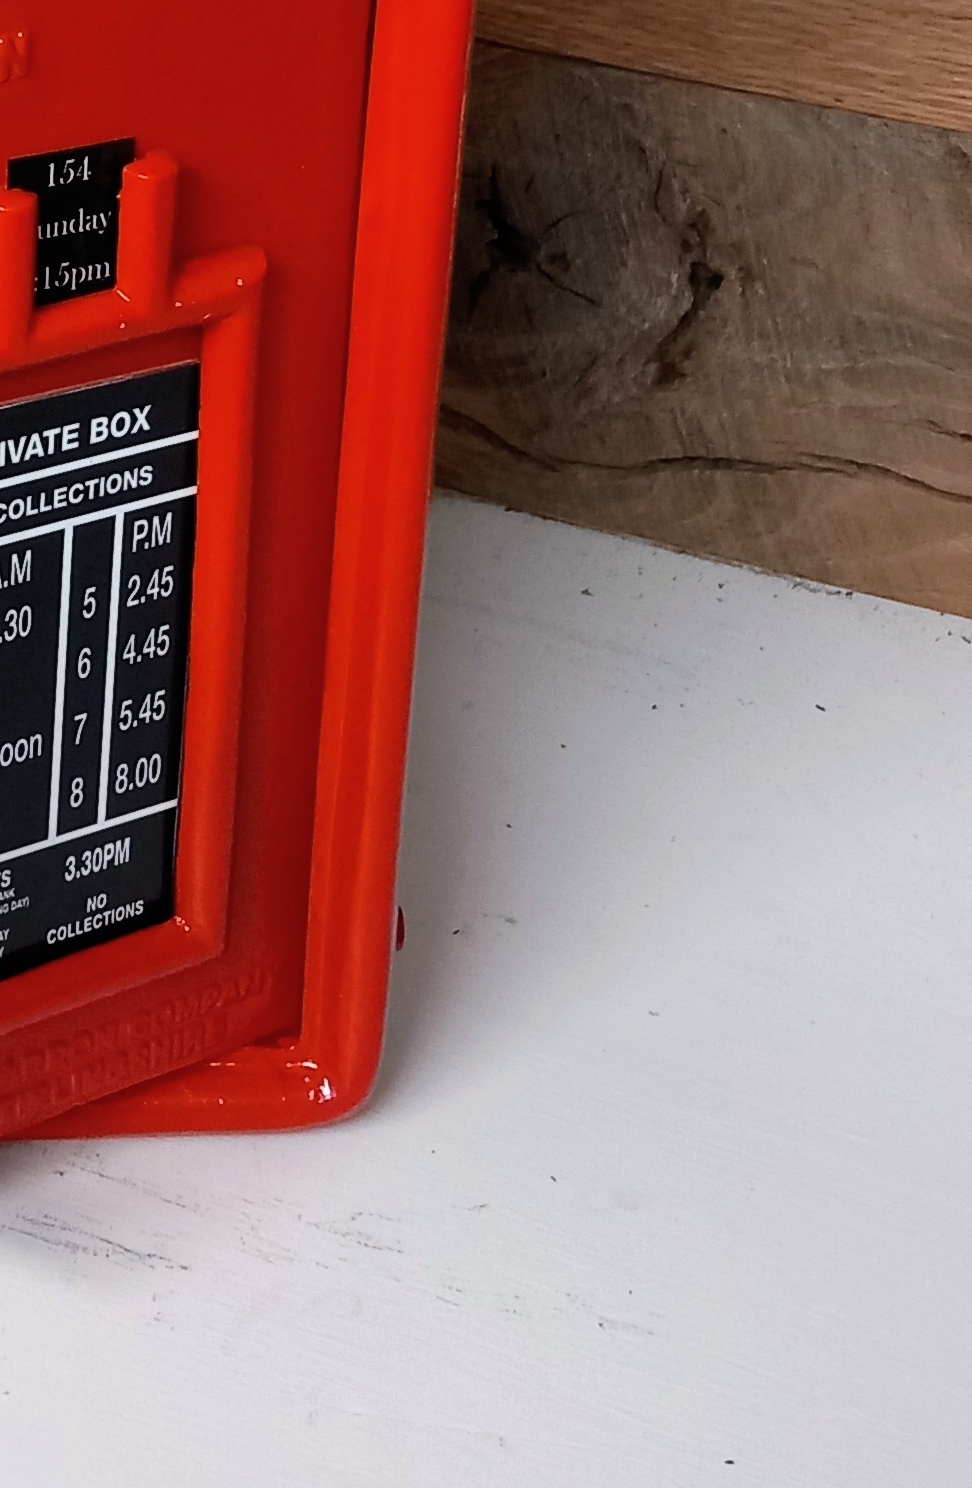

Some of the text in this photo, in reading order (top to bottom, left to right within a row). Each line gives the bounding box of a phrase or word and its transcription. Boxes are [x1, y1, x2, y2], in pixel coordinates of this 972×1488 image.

[48, 156, 91, 187] 154
[38, 208, 112, 241] unday
[89, 404, 153, 445] BOX
[131, 511, 173, 553] P.M
[82, 565, 175, 620] 5 2.45
[77, 624, 171, 679] 6 4.45
[73, 689, 167, 746] 7 5.45
[69, 753, 162, 809] 8 8.00
[64, 837, 131, 882] 3.30PM
[46, 899, 146, 945] COLLECTIONS
[86, 893, 108, 914] NO
